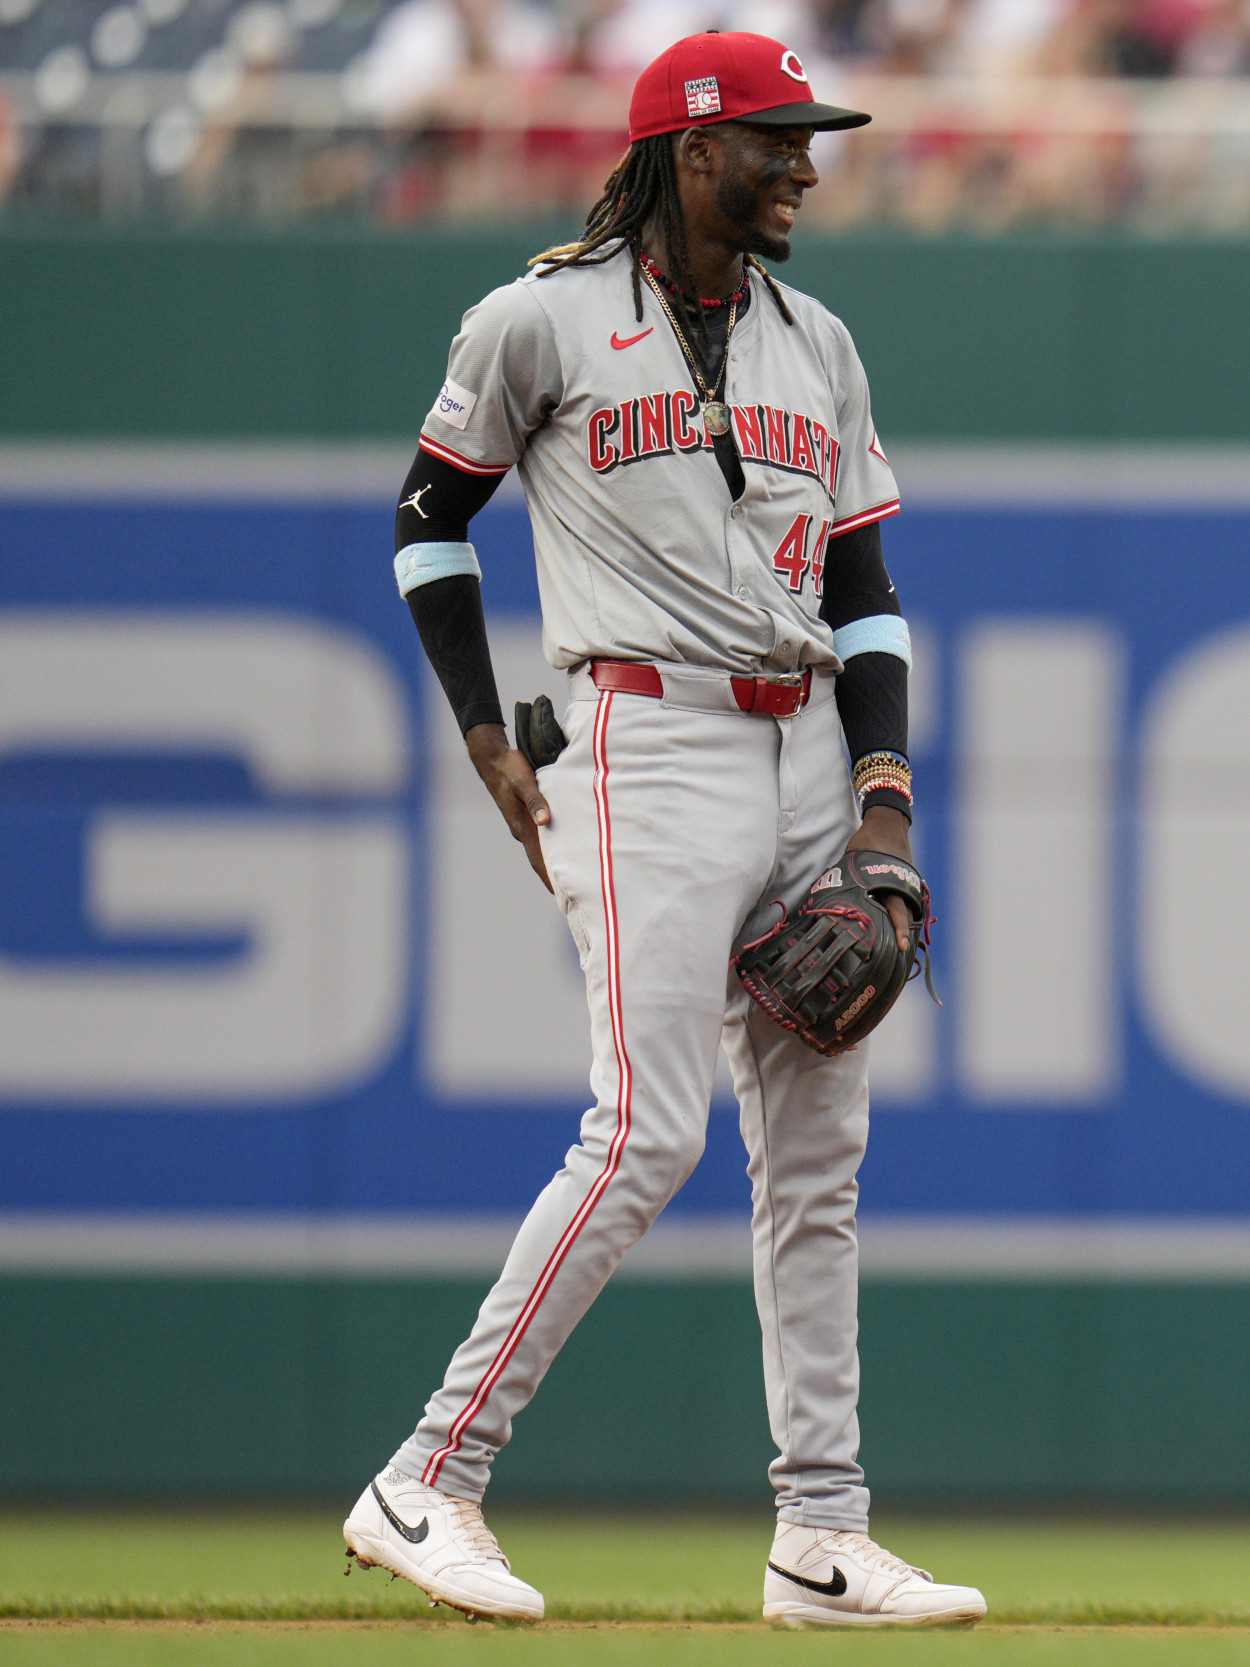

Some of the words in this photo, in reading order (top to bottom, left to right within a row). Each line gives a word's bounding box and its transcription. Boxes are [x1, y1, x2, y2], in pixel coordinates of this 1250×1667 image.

[780, 50, 808, 84] C
[772, 512, 832, 599] 44
[834, 984, 876, 1032] A2000
